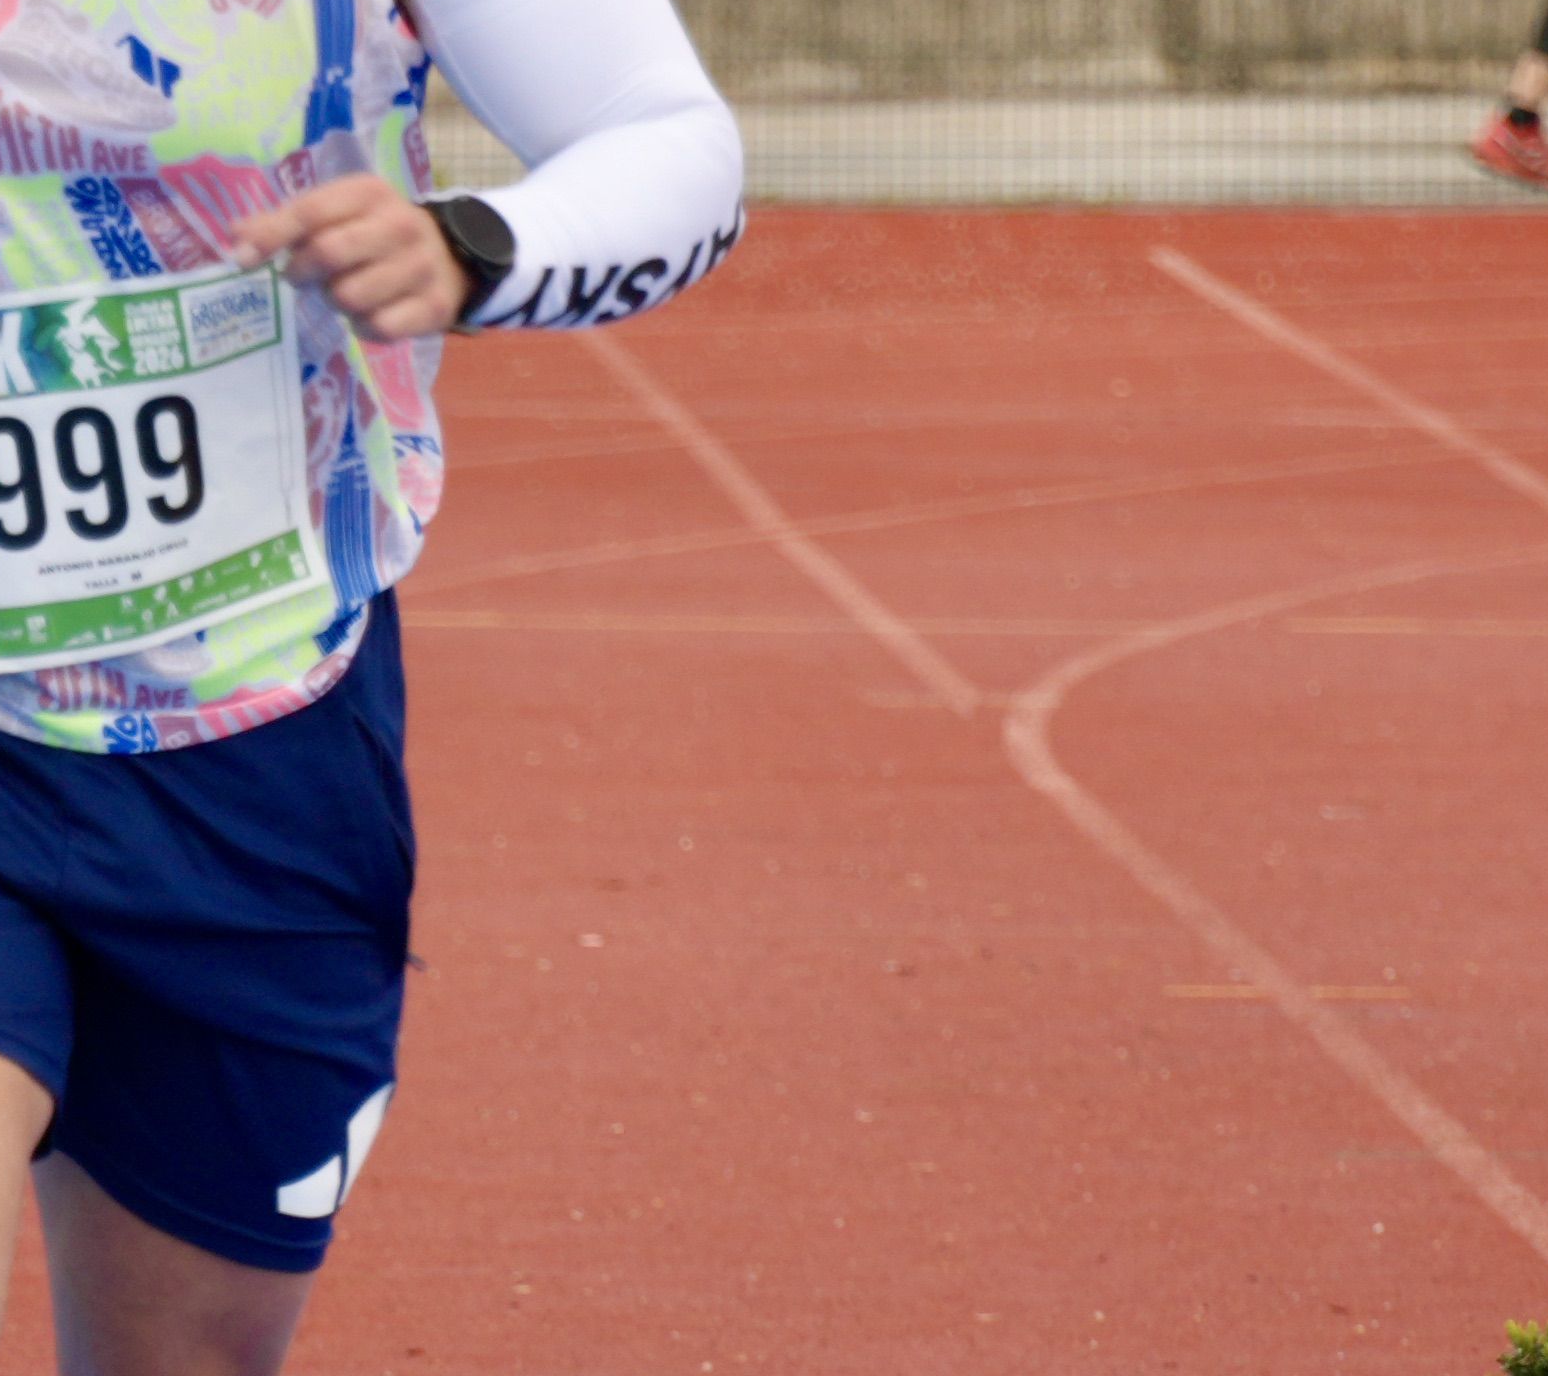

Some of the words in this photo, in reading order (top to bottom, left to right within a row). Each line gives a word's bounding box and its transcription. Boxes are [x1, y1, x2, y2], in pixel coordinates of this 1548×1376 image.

[92, 139, 152, 174] AVE
[133, 346, 186, 376] 2026
[131, 570, 143, 582] M
[134, 683, 189, 709] AVE
